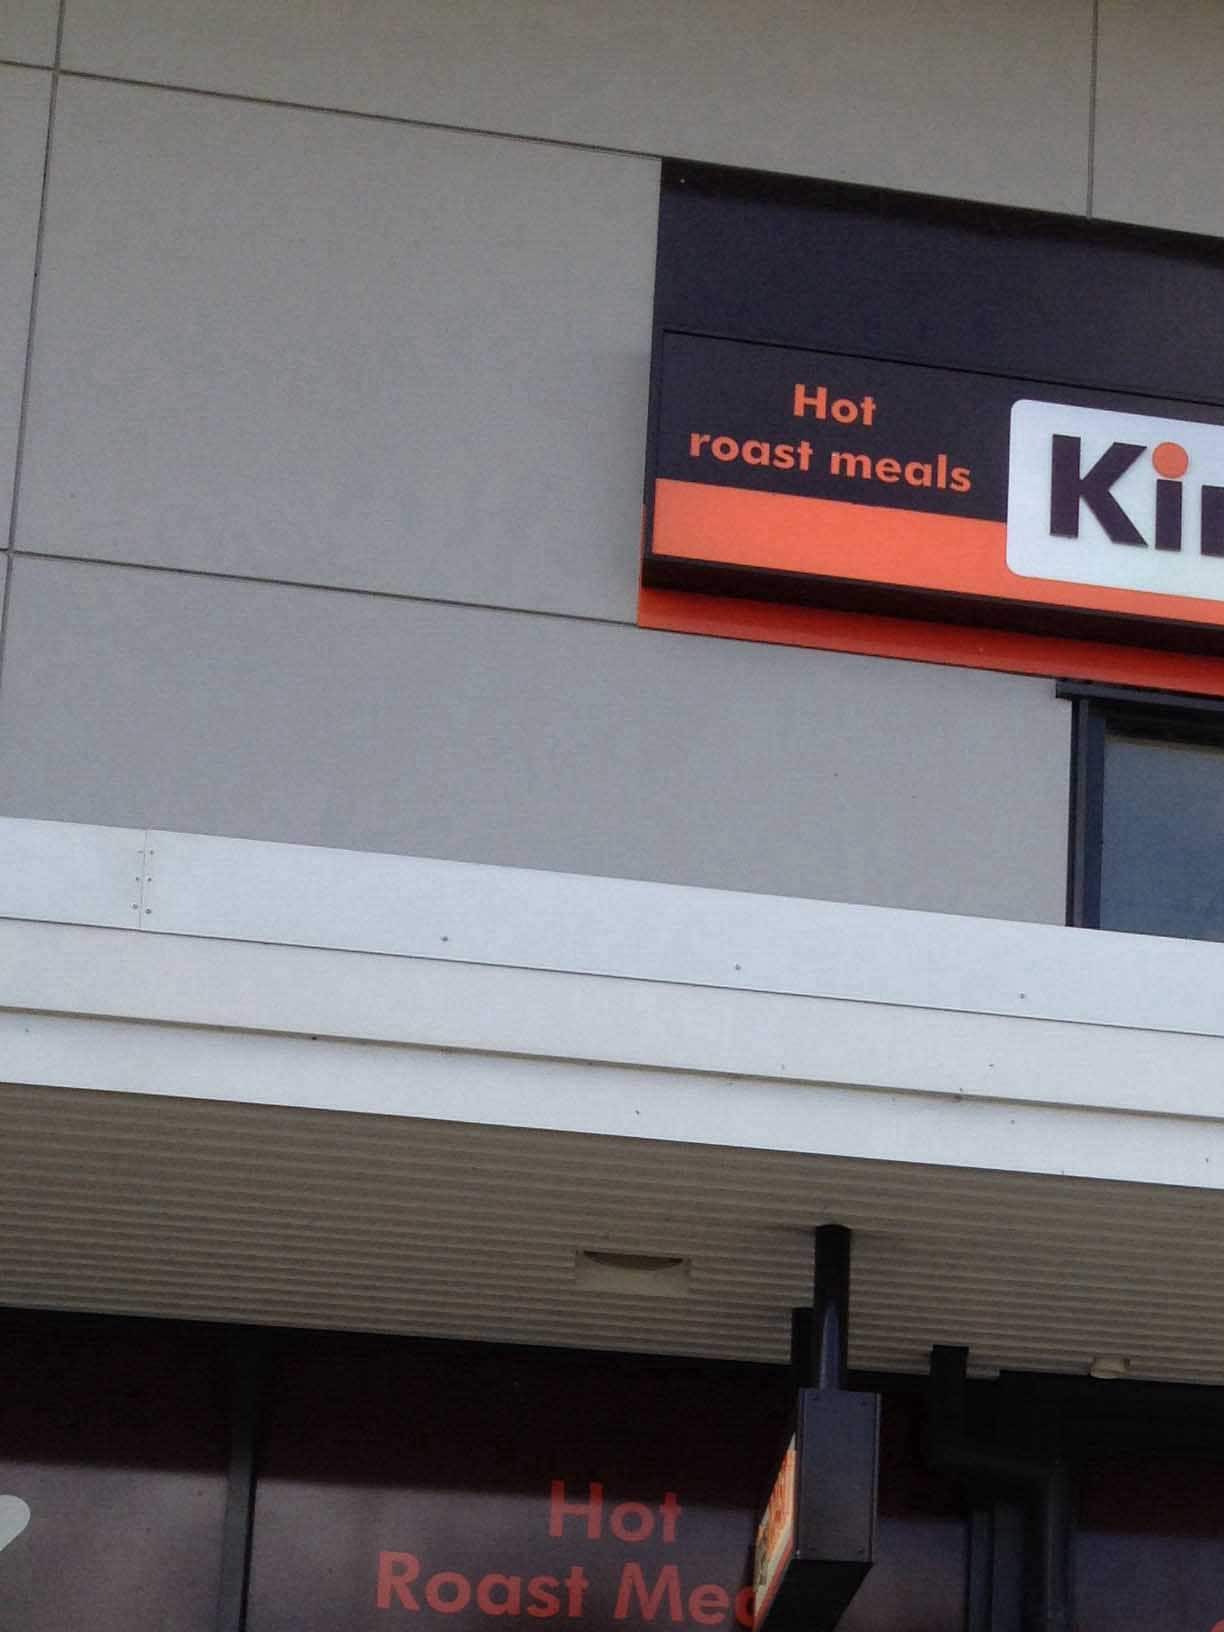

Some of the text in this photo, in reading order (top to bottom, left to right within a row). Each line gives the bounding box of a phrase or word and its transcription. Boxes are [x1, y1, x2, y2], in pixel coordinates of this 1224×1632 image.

[793, 383, 876, 427] Hot
[689, 429, 972, 494] roast meals
[548, 1480, 682, 1544] Hot
[376, 1550, 758, 1628] Roast Mea
